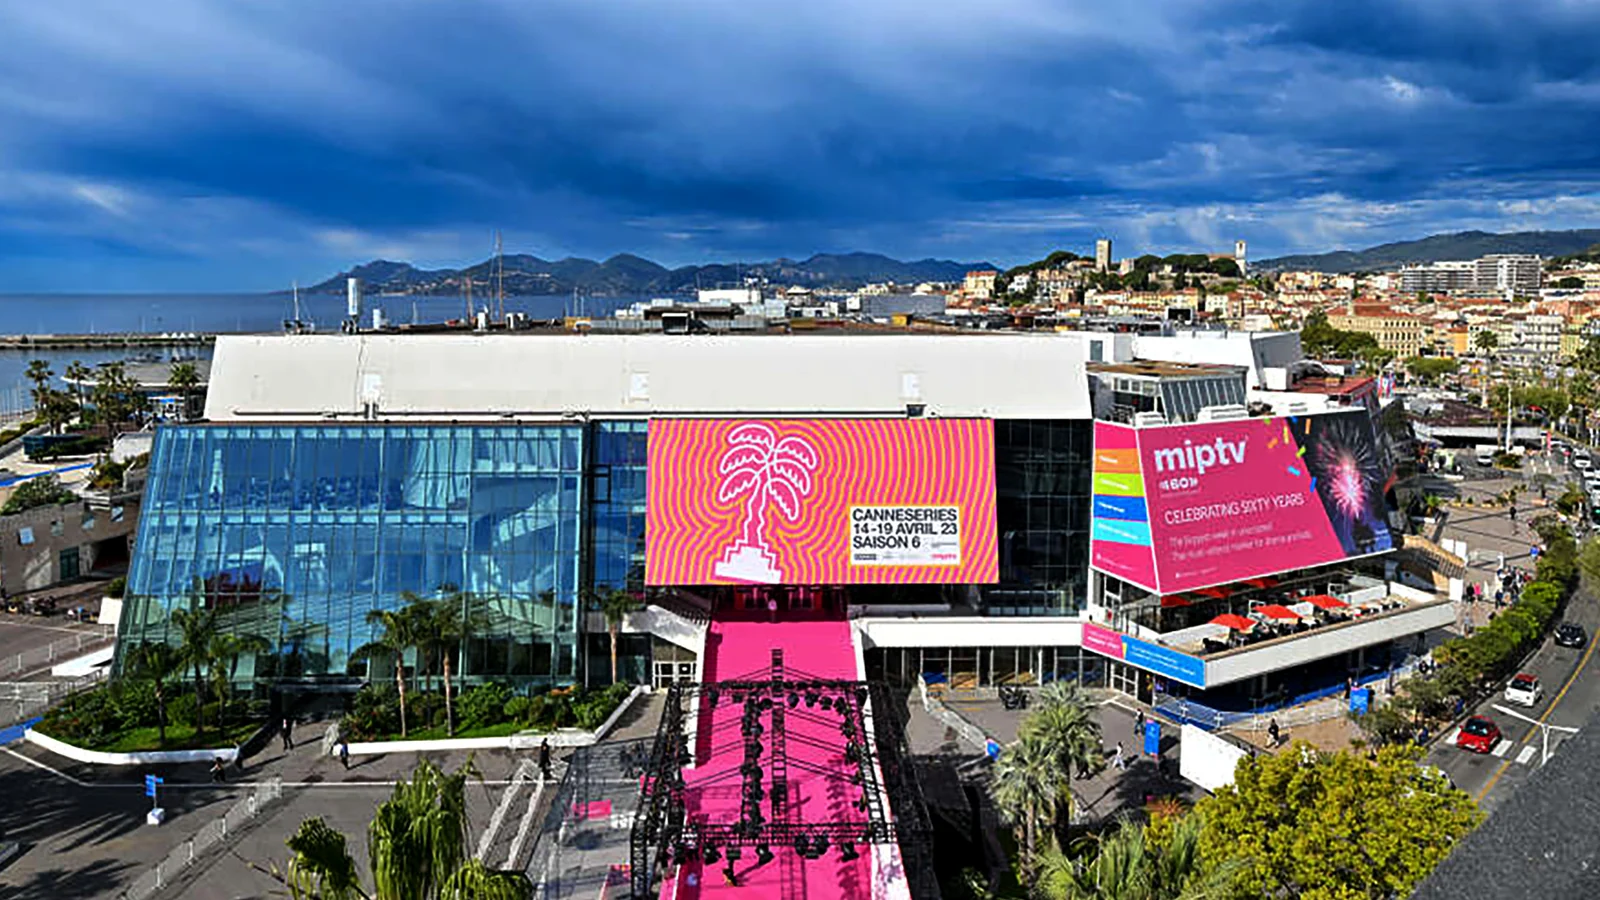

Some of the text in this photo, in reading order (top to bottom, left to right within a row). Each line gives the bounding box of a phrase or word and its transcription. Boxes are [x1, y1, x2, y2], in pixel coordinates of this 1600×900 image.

[1154, 437, 1247, 474] miptv
[853, 508, 958, 522] CANNESERIES
[1164, 493, 1305, 525] CELEBRATING SIXTY YEARS
[854, 523, 958, 535] 14-19 AVRIL 23
[853, 536, 909, 549] SAISON
[912, 536, 921, 549] 6
